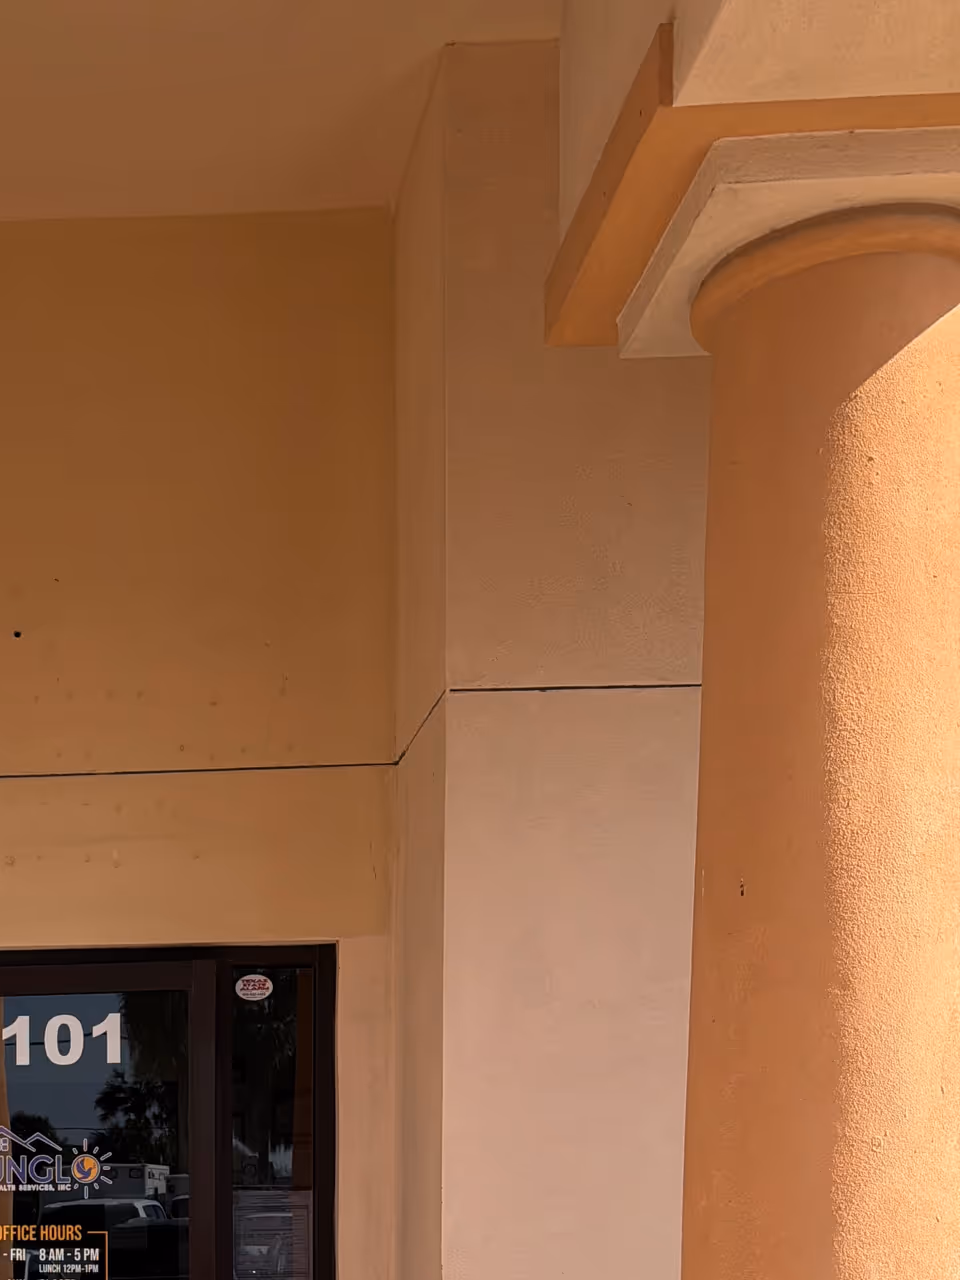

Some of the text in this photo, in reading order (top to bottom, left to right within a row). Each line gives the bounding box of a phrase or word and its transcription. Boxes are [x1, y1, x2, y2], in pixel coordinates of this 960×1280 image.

[40, 1225, 82, 1241] HOURS
[10, 1248, 26, 1261] FRI
[39, 1248, 46, 1261] 8
[48, 1248, 65, 1261] AM
[74, 1248, 81, 1261] 5
[83, 1248, 100, 1261] PM
[39, 1264, 99, 1273] LUNCH 12PM-1PM
